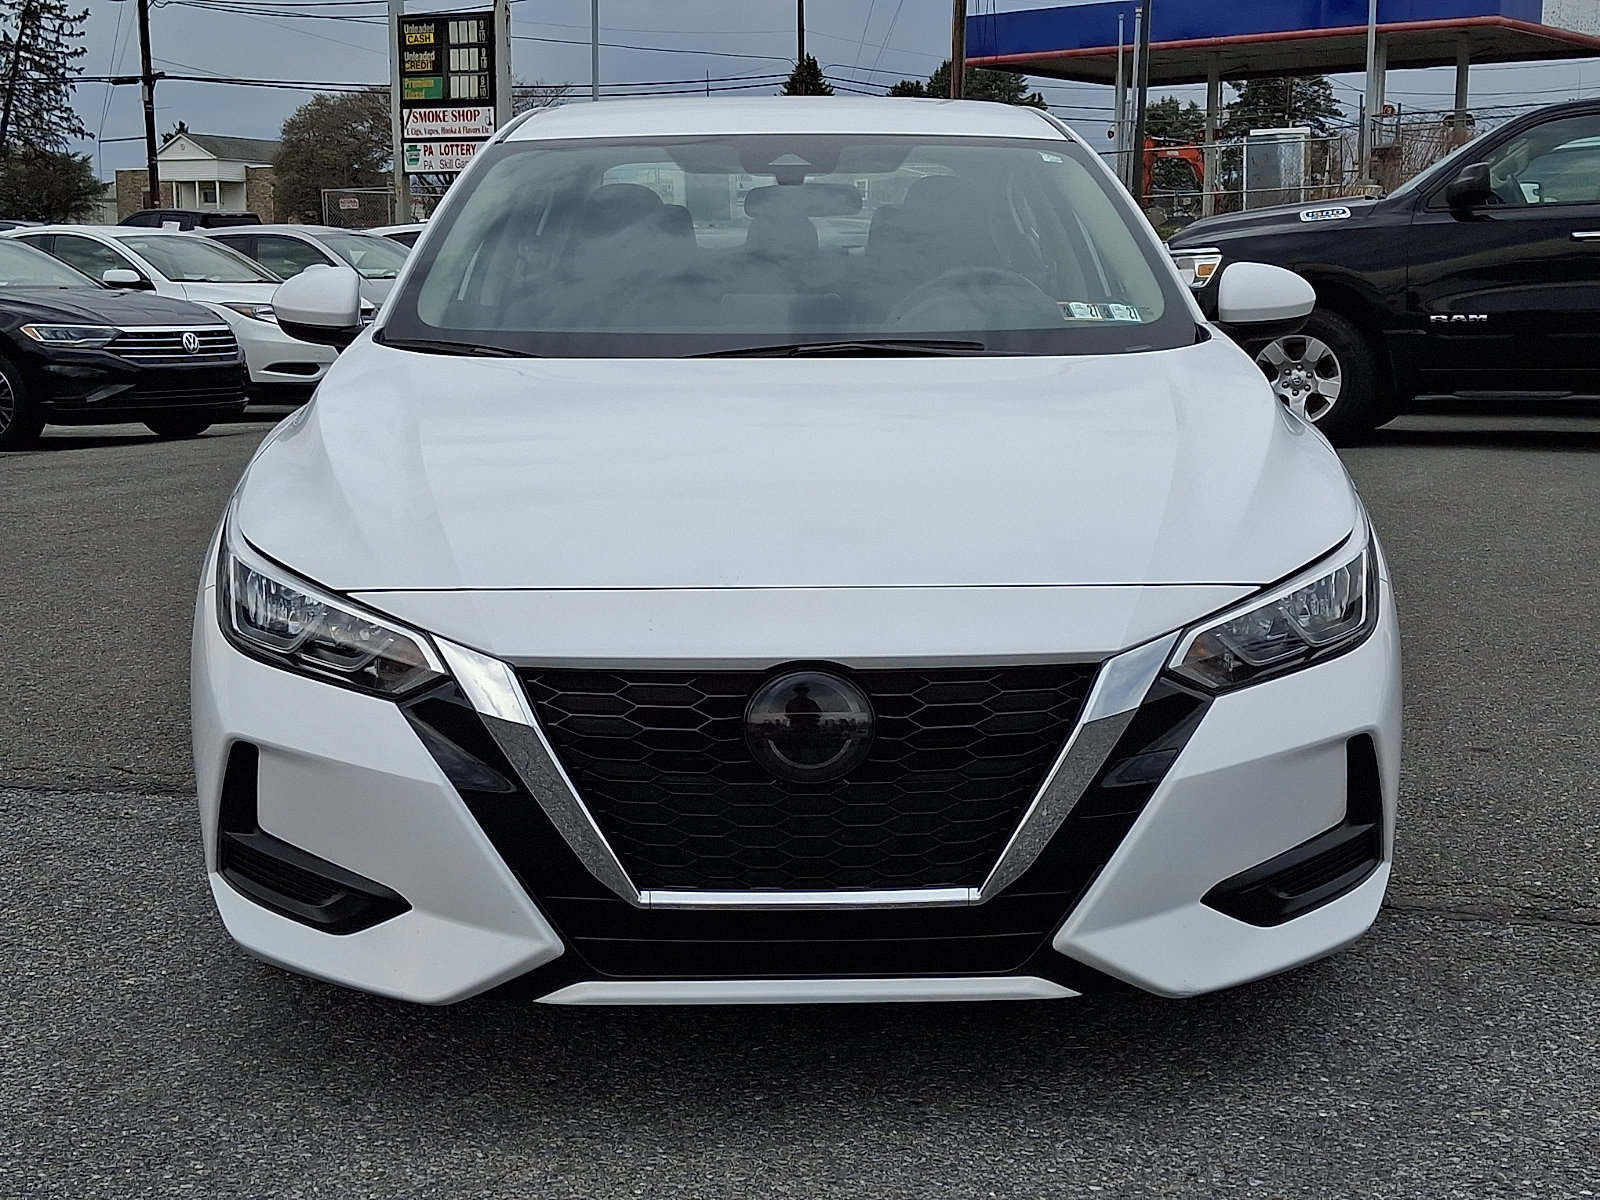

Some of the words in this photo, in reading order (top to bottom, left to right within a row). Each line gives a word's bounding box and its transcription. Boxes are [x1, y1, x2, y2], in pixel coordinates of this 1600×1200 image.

[404, 23, 434, 34] Unleaded
[407, 34, 431, 44] CASH
[404, 51, 435, 61] Unleaded
[405, 61, 433, 70] CREDIT
[412, 110, 448, 124] SMOKE
[451, 109, 480, 122] SHOP
[424, 144, 434, 156] PA
[440, 144, 476, 156] LOTTERY
[424, 160, 434, 170] PA
[440, 159, 454, 170] Skill
[1430, 314, 1488, 322] RAM
